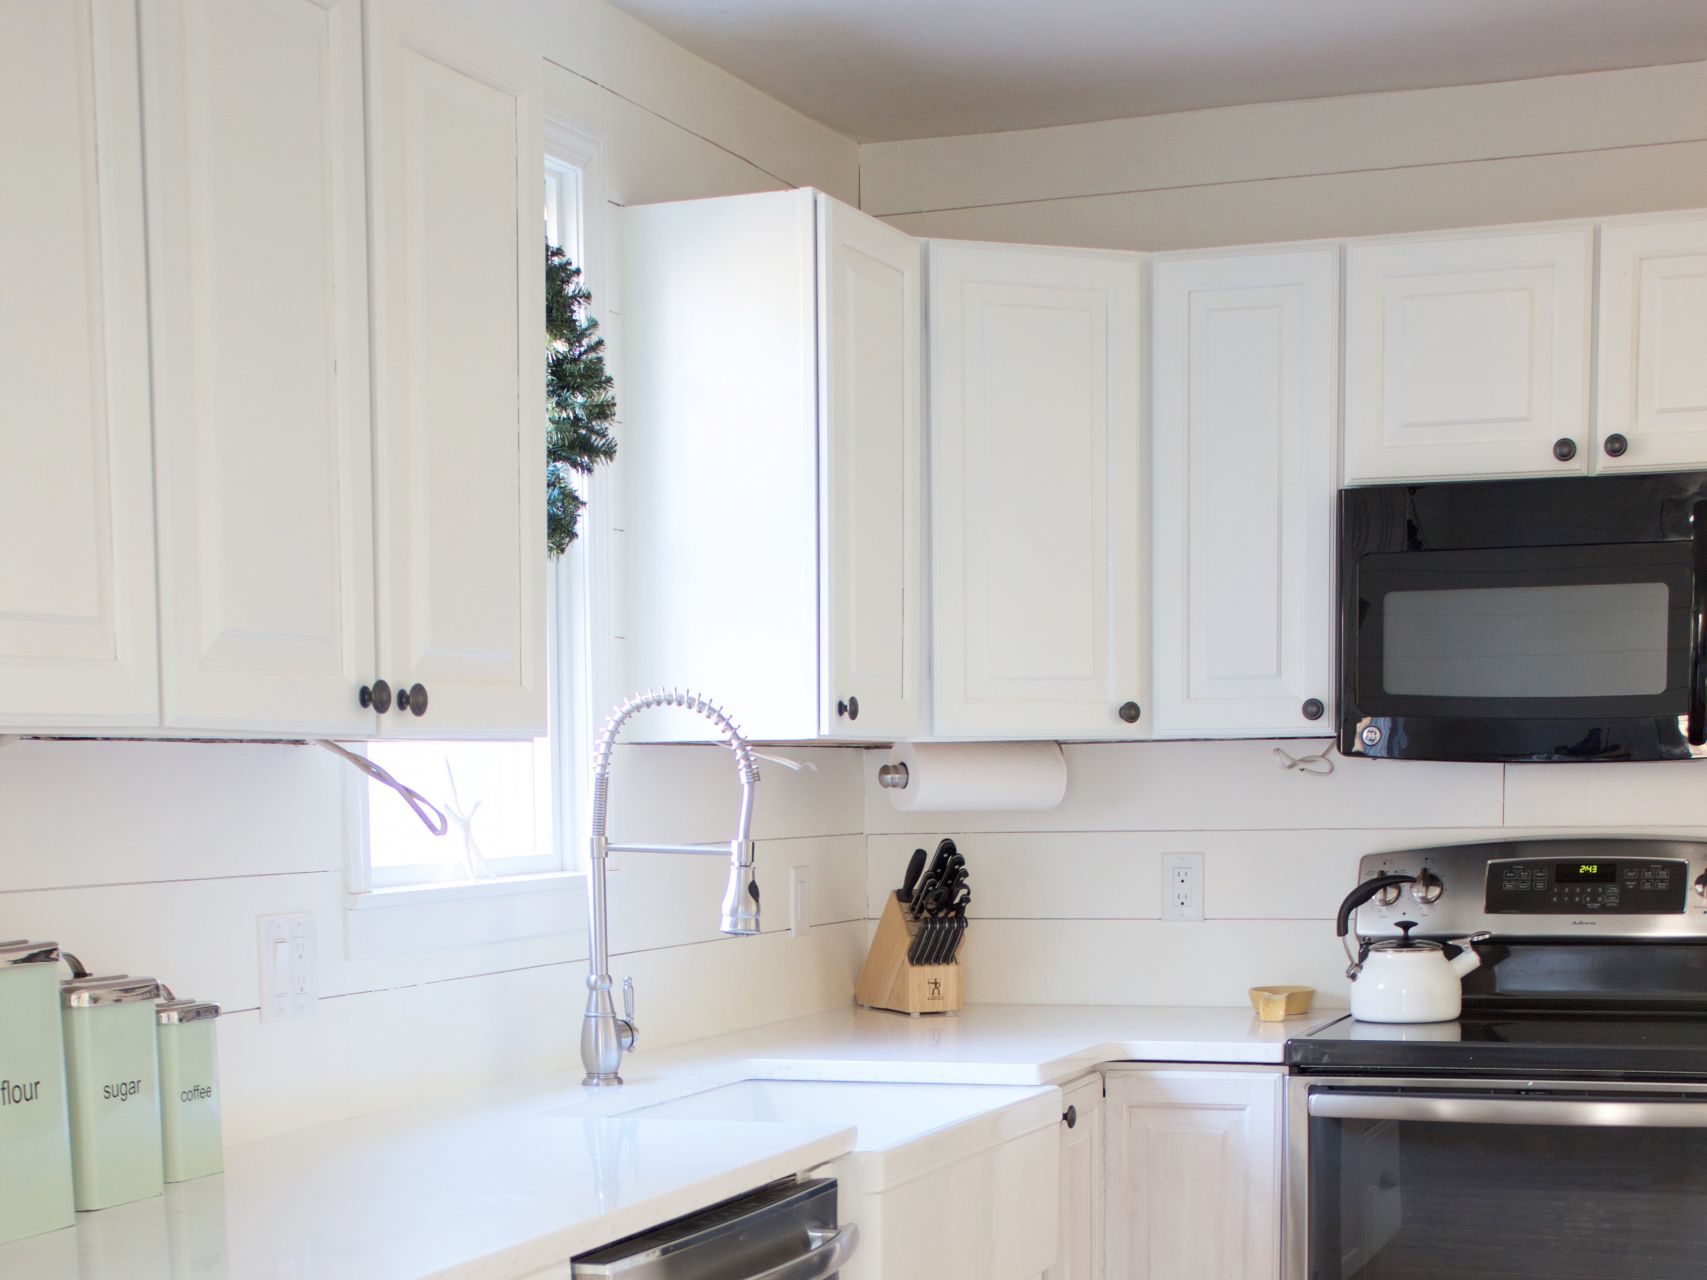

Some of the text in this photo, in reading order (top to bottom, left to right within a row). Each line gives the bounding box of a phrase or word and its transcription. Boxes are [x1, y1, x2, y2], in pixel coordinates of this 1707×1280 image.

[1579, 865, 1598, 873] 2:43
[1, 1079, 40, 1106] flour
[103, 1079, 142, 1102] sugar
[180, 1084, 212, 1103] coffee
